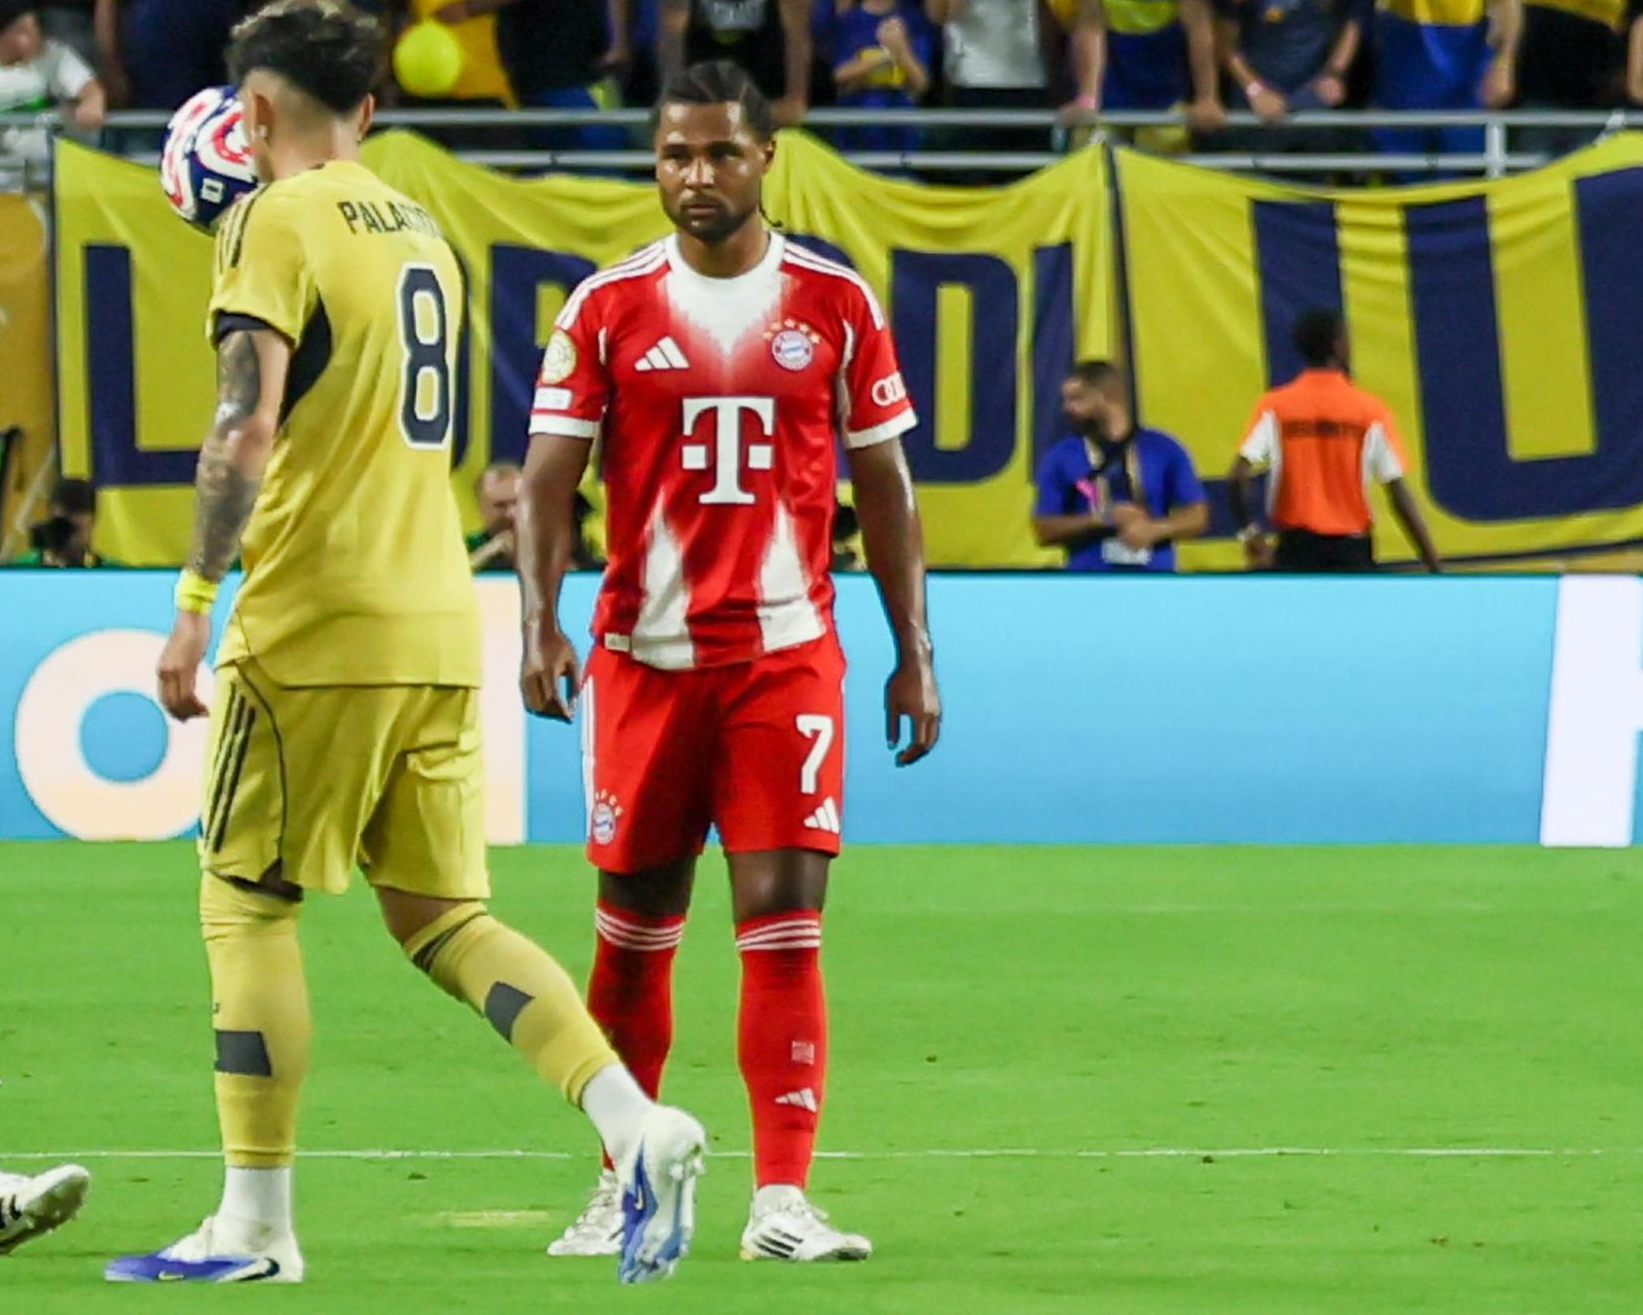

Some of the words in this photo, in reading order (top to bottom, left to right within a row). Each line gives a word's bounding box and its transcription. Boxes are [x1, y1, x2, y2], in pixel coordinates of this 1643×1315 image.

[338, 200, 443, 237] PALA
[395, 261, 453, 449] 8
[795, 713, 834, 795] 7
